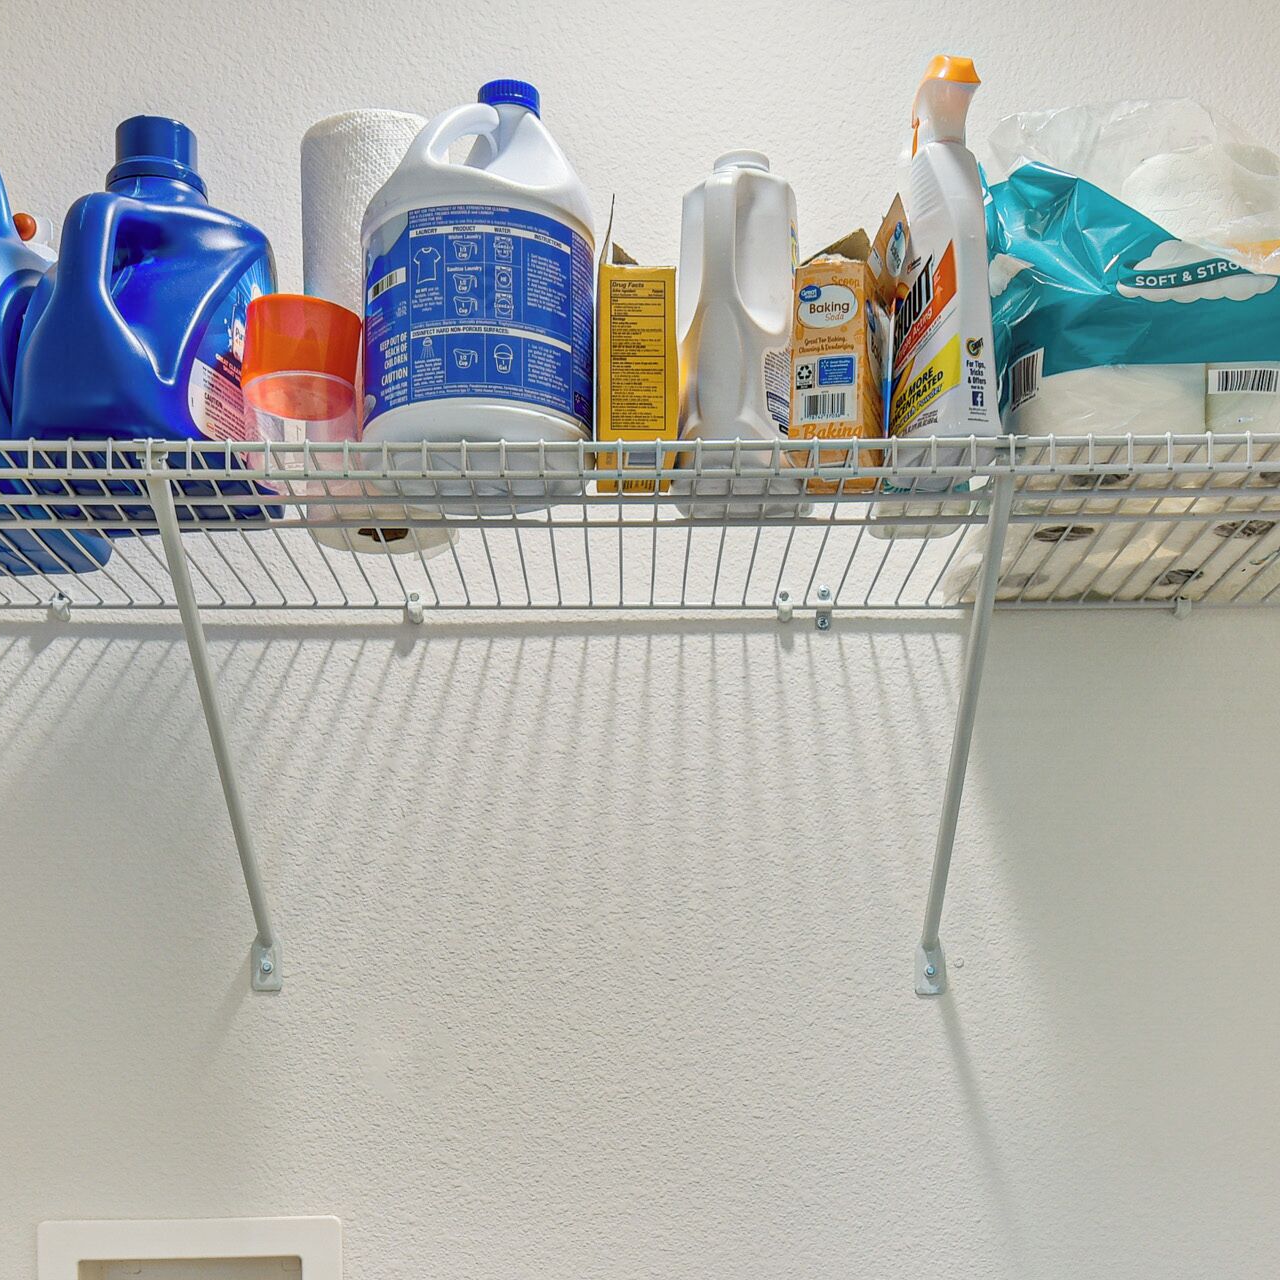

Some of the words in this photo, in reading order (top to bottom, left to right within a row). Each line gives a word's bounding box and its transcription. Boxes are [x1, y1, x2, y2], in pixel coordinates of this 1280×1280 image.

[415, 228, 438, 236] LAUNDRY
[1135, 273, 1177, 286] SOFT
[1182, 271, 1192, 281] &
[1197, 261, 1240, 278] STRO
[832, 275, 860, 287] Scoop
[809, 302, 850, 314] Baking
[825, 313, 844, 321] Soda
[400, 332, 407, 342] OF
[412, 328, 435, 337] DISINFECT
[400, 342, 408, 352] OF
[384, 353, 408, 370] CHILDREN
[381, 366, 408, 386] CAUTION
[908, 366, 934, 396] MORE
